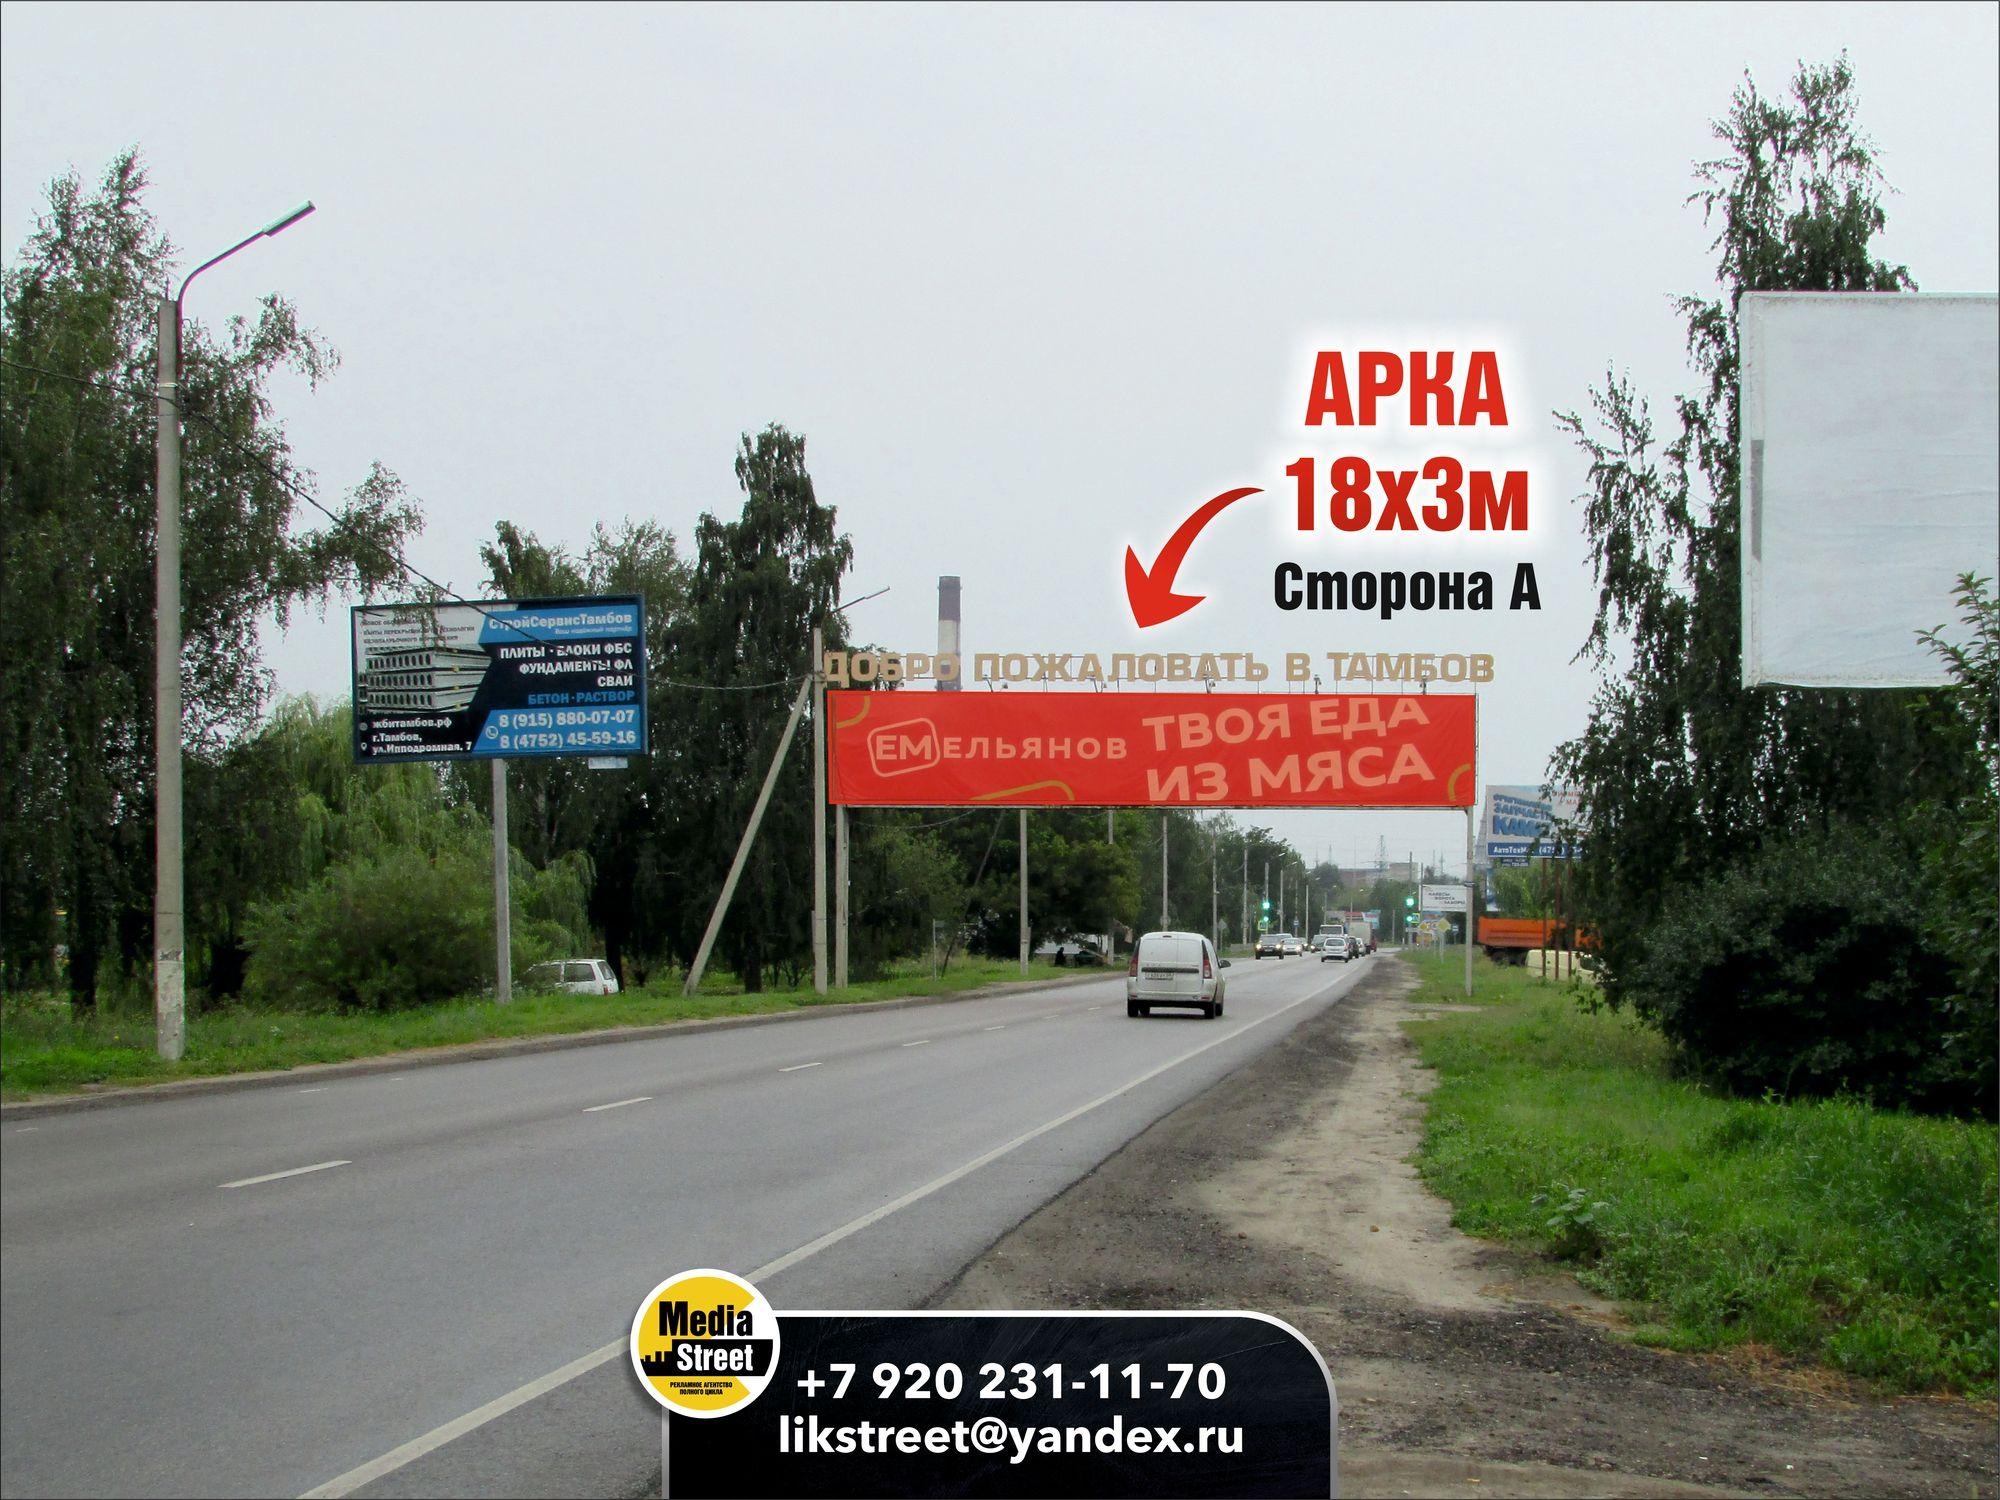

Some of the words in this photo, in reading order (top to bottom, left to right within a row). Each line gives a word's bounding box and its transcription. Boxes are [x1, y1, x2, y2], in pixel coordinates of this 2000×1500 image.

[489, 612, 632, 630] СтройСервисТамбов
[500, 646, 546, 659] ПЛИТЫ
[556, 644, 601, 657] БЛОКИ
[604, 642, 633, 654] ФБС
[519, 661, 611, 675] ФУНДАМЕНТЫ
[613, 659, 633, 671] ФЛ
[823, 652, 960, 688] ДОБРО
[974, 652, 1269, 683] ПОЖАЛОВАТЬ
[1286, 652, 1311, 682] В
[1327, 652, 1494, 683] ТАМБОВ
[597, 675, 633, 687] СВАИ
[528, 692, 569, 705] БЕТОН
[576, 690, 636, 703] РАСТВОР
[372, 717, 453, 728] жбитамбов.рф
[499, 714, 510, 728] 8
[512, 712, 553, 730] (915)
[556, 709, 636, 726] 880-07-07
[1142, 703, 1291, 751] ТВОЯ
[1309, 697, 1429, 740] ЕДА
[372, 732, 423, 743] г.Тамбов,
[466, 741, 472, 750] 7
[499, 735, 510, 748] 8
[513, 732, 564, 750] (4752)
[567, 730, 636, 746] 45-59-16
[875, 735, 1127, 760] ЕМЕЛЬЯНОВ
[1146, 762, 1229, 802] ИЗ
[1249, 743, 1436, 797] МЯСА
